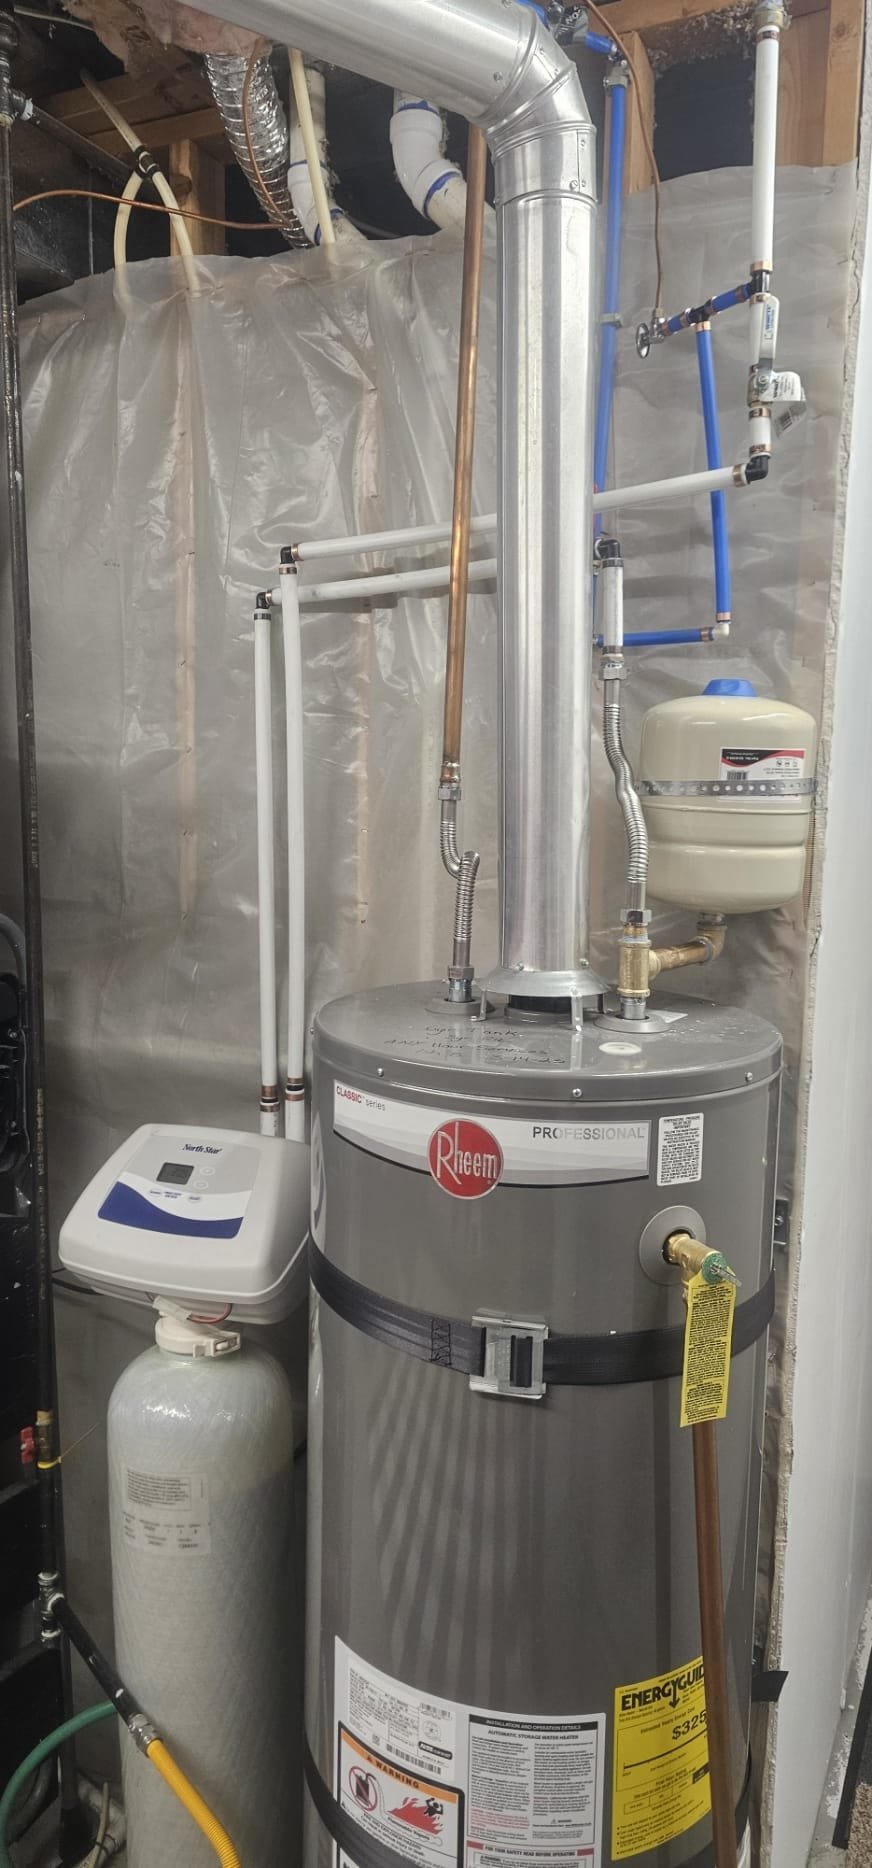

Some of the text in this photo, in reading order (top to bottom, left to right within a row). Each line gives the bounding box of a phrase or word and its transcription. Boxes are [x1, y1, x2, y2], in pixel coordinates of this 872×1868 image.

[365, 1099, 386, 1112] series
[182, 1143, 204, 1153] North
[532, 1126, 646, 1140] PROFESSIONAL
[436, 1121, 498, 1185] Rheem
[621, 1664, 704, 1712] ENERGYGUID
[672, 1709, 706, 1741] $325
[375, 1759, 419, 1789] WARNING
